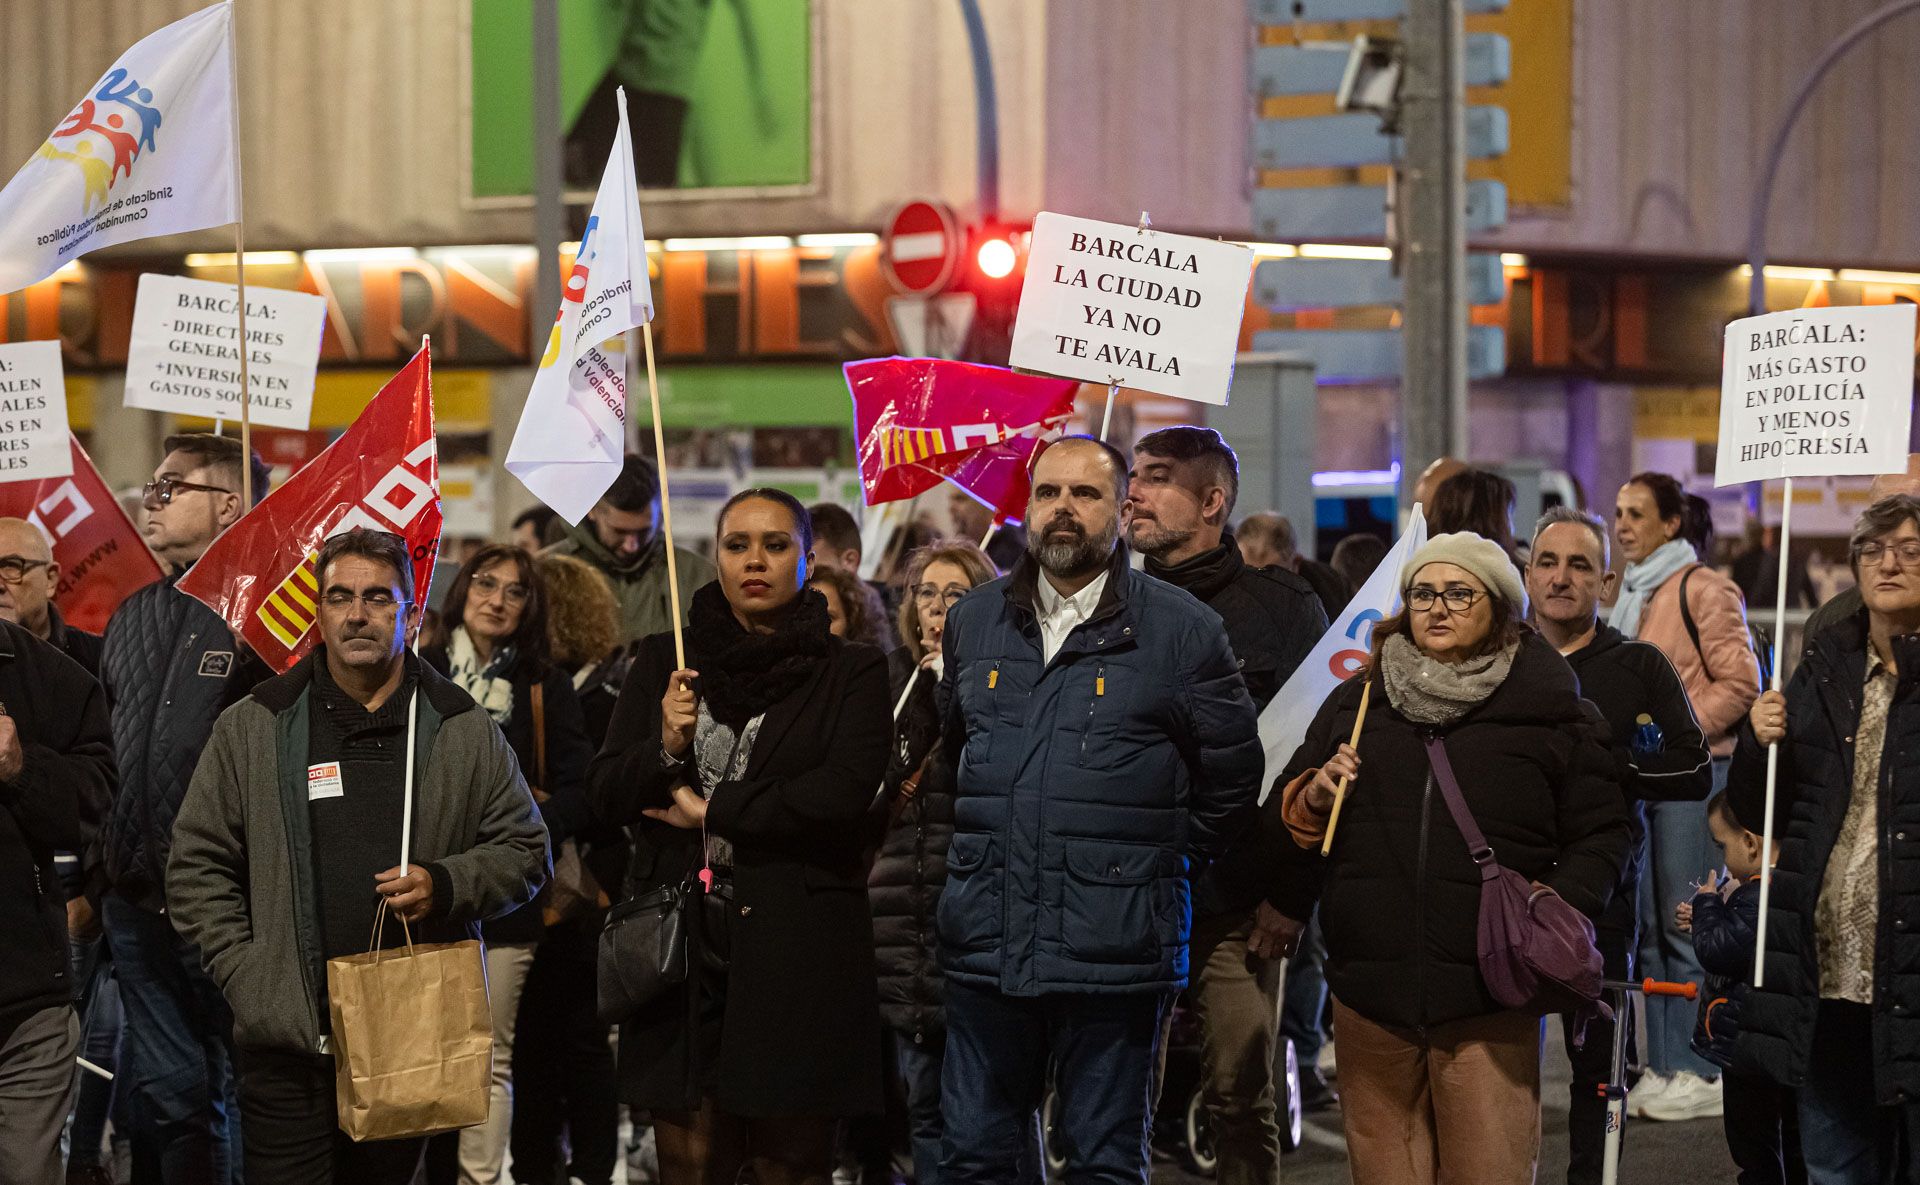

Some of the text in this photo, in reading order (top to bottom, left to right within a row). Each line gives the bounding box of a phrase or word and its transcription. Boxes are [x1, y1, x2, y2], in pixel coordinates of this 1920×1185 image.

[1069, 232, 1200, 274] BARCALA
[1053, 264, 1202, 309] LA CIUDAD
[1082, 304, 1162, 337] YA NO
[168, 339, 273, 365] GENERAES
[1750, 324, 1865, 352] BARCALA:
[1055, 334, 1181, 377] TE AVALA
[1747, 356, 1866, 381] MÁS GASTO
[150, 380, 212, 400] GASTOS
[266, 376, 289, 391] EN
[1745, 379, 1865, 408] EN POLICÍA
[20, 418, 41, 432] EN
[1758, 410, 1851, 433] Y MENOS
[1740, 433, 1869, 462] HIPOCRESÍA
